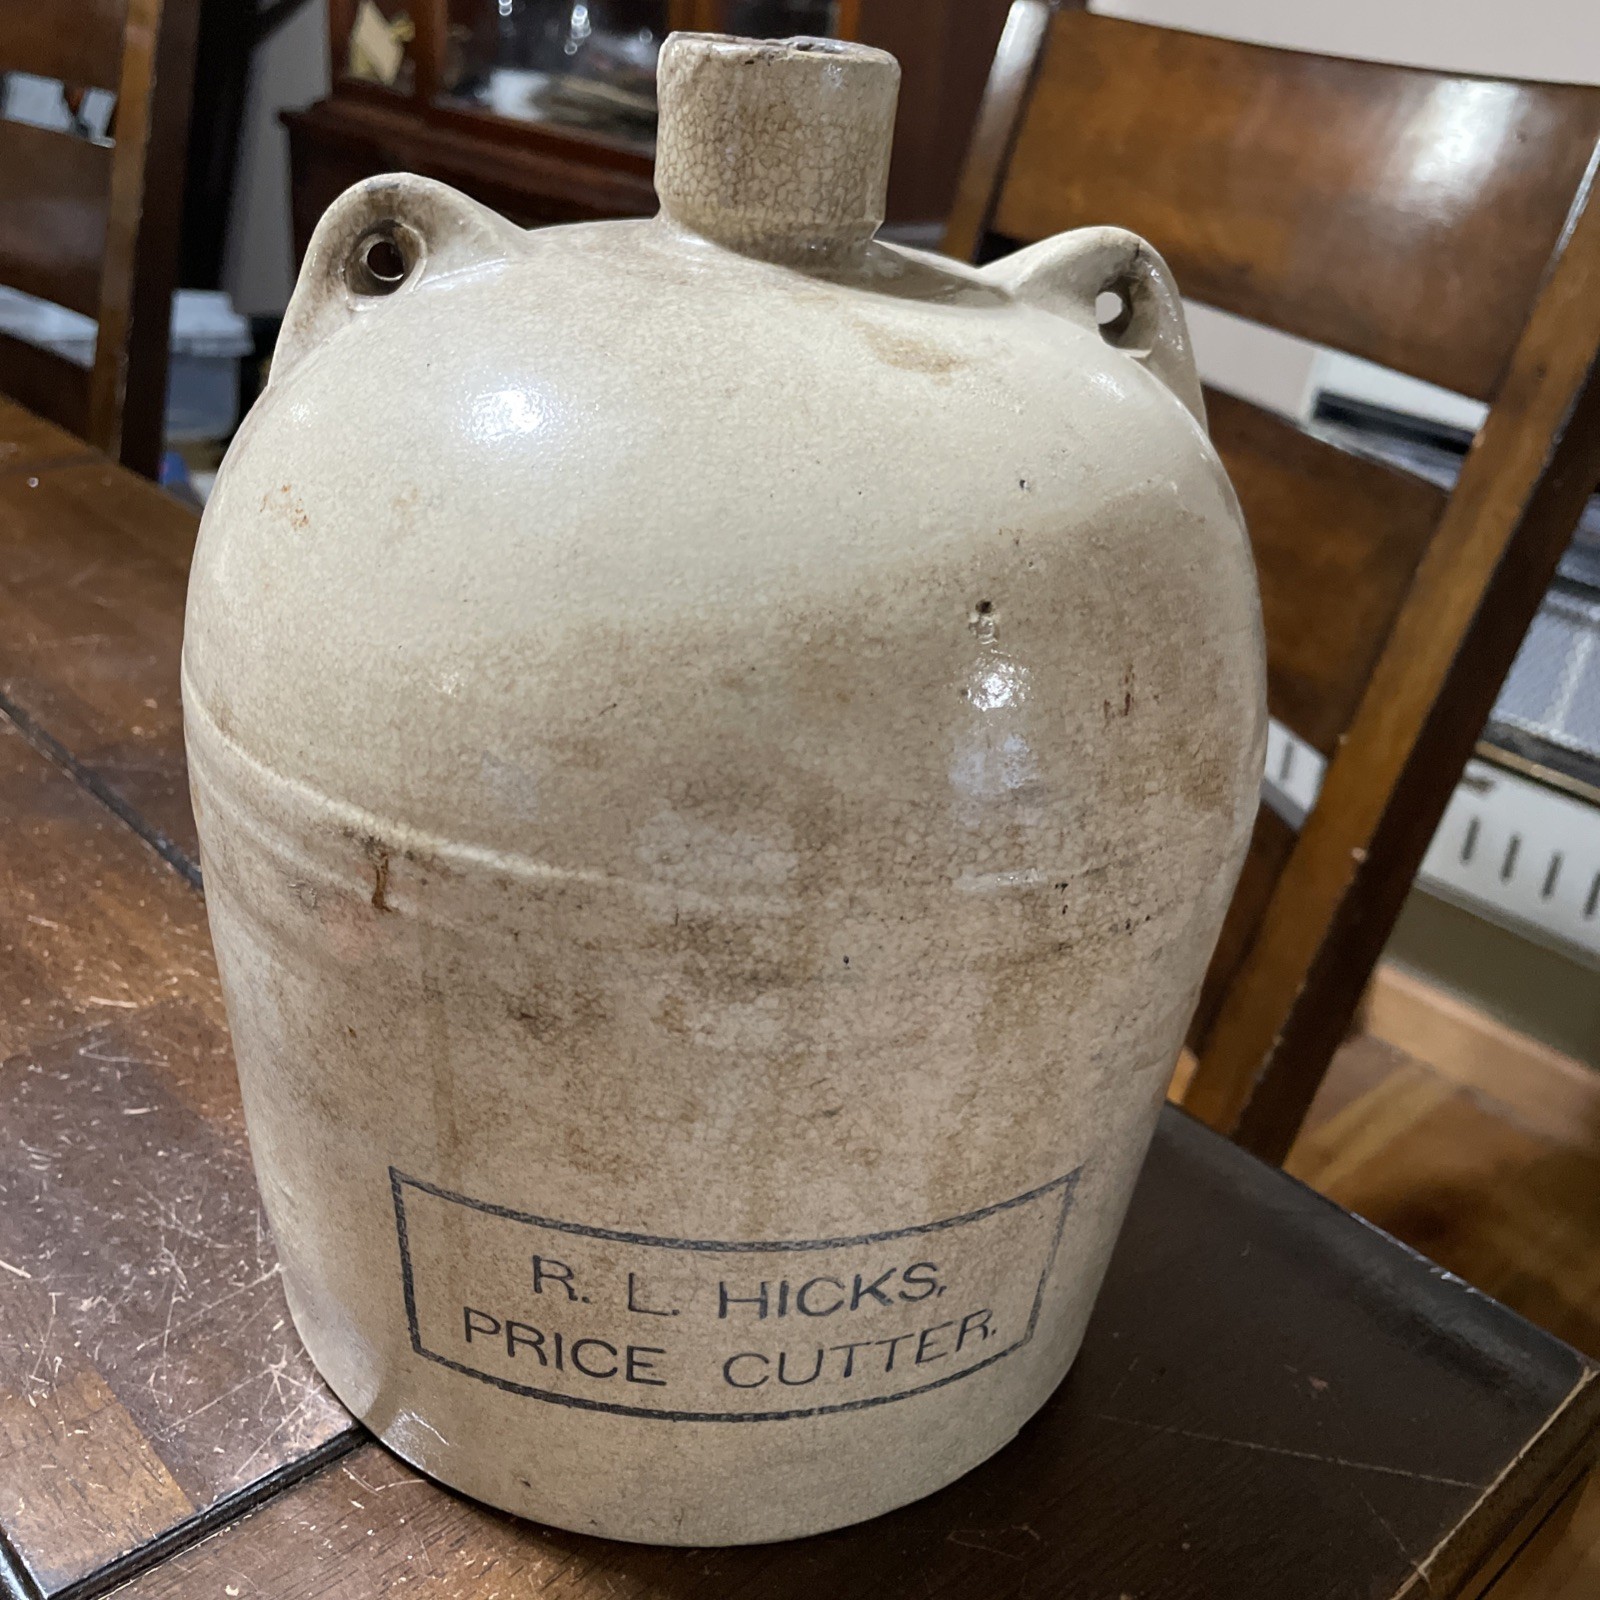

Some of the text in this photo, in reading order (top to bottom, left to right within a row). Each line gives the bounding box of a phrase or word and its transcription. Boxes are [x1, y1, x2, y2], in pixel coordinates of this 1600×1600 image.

[532, 1254, 590, 1303] R.
[627, 1272, 679, 1317] L.
[463, 1306, 997, 1388] PRICE CUTTER.
